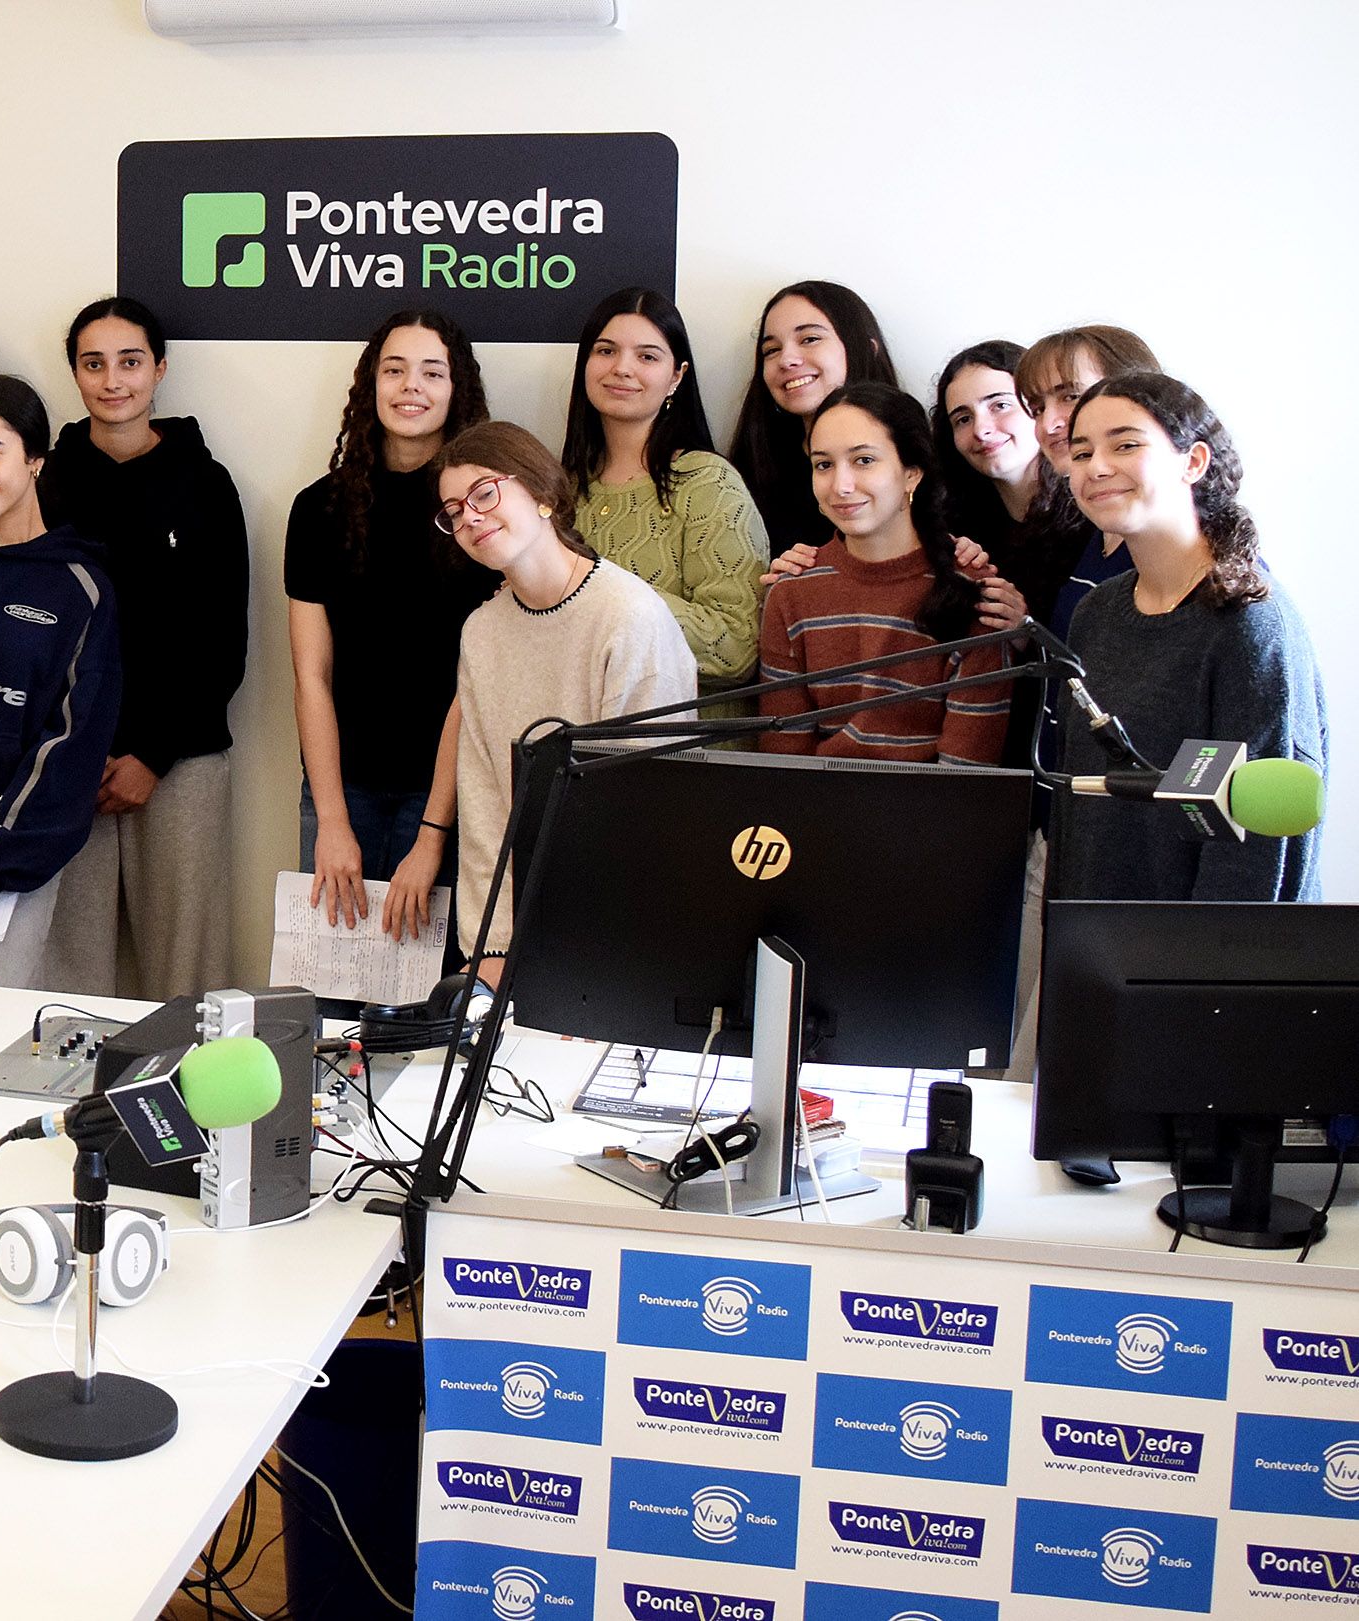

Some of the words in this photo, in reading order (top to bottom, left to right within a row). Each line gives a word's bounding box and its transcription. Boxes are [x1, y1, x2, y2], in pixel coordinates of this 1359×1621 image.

[286, 187, 604, 236] Pontevedra
[287, 243, 404, 289] Viva
[422, 242, 576, 290] Radio
[735, 825, 788, 880] hp
[137, 1097, 165, 1138] Pontevedra
[161, 1119, 174, 1137] Viva
[456, 1264, 581, 1299] PonteVedra
[447, 1300, 585, 1318] www.pontevedraviva.com
[639, 1293, 698, 1309] Pontevedra
[709, 1296, 746, 1317] Viva
[757, 1304, 788, 1317] Radio
[853, 1298, 987, 1336] PonteVedra
[843, 1336, 991, 1356] www.pontevedraviva.com
[1049, 1330, 1112, 1347] Pontevedra
[1123, 1333, 1162, 1356] Viva
[1175, 1342, 1207, 1355] Radio
[440, 1379, 498, 1393] Pontevedra
[508, 1381, 543, 1401] Viva
[554, 1390, 584, 1402] Radio
[646, 1385, 776, 1422] PonteVedra
[637, 1420, 779, 1442] www.pontevedraviva.com
[835, 1418, 896, 1434] Pontevedra
[908, 1420, 945, 1442] Viva
[956, 1429, 988, 1442] Radio
[1055, 1423, 1192, 1463] PonteVedra
[1045, 1460, 1196, 1482] www.pontevedraviva.com
[1255, 1458, 1319, 1473] Pontevedra
[1330, 1461, 1359, 1480] Viv
[449, 1466, 572, 1502] PonteVedra
[440, 1503, 576, 1525] www.pontevedraviva.com
[629, 1500, 688, 1516] Pontevedra
[698, 1505, 736, 1527] Viva
[746, 1513, 777, 1526] Radio
[842, 1508, 974, 1546] PonteVedra
[832, 1545, 978, 1568] www.pontevedraviva.com
[1036, 1543, 1098, 1559] Pontevedra
[1108, 1547, 1148, 1569] Viva
[1159, 1556, 1191, 1569] Radio
[432, 1581, 488, 1596] Pontevedra
[498, 1585, 533, 1606] Viva
[544, 1594, 573, 1607] Radio
